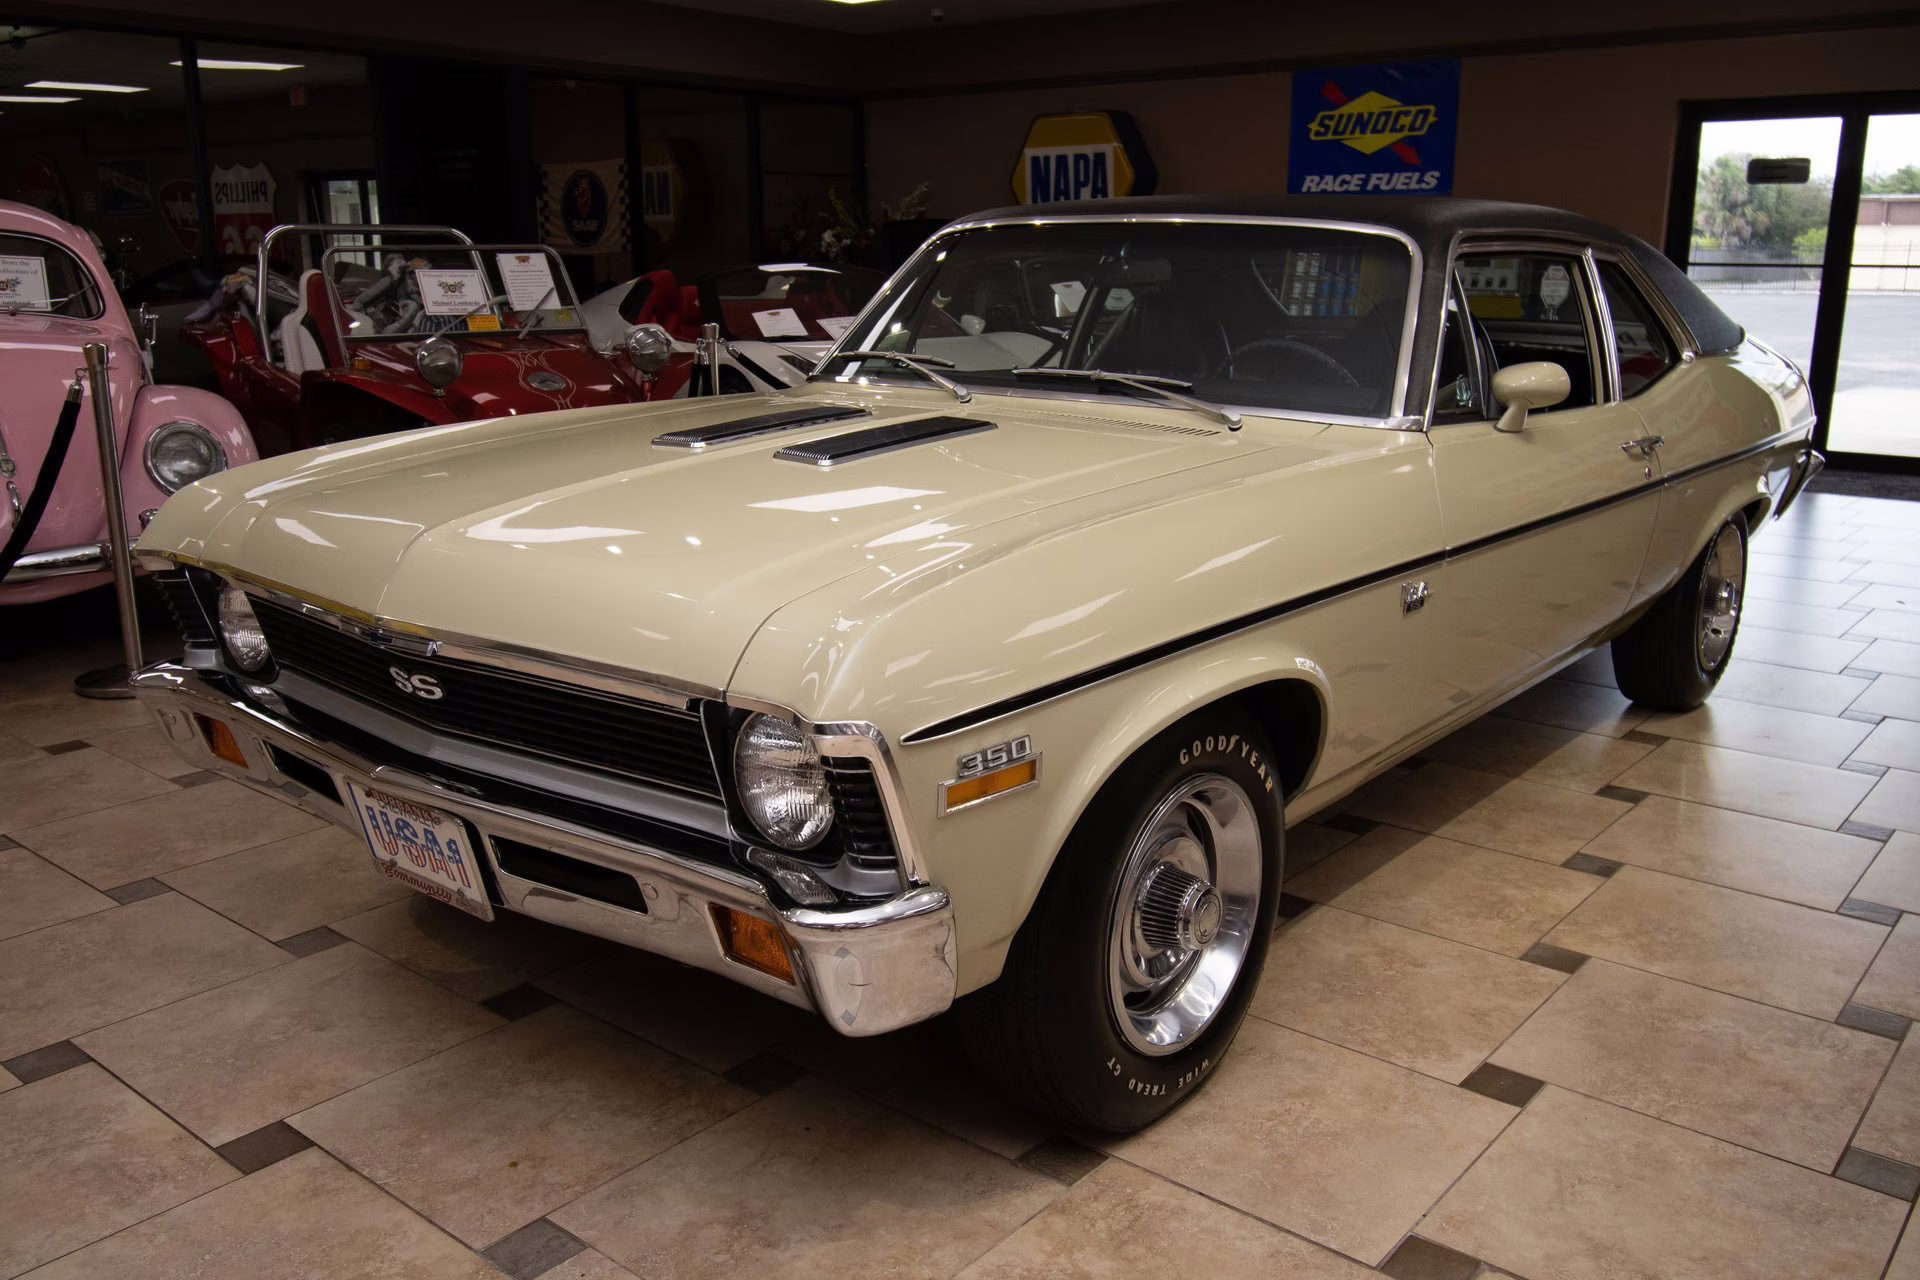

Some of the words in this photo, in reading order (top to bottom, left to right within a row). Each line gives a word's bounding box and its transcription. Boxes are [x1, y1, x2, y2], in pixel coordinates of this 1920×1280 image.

[1313, 108, 1432, 137] SUNOCO
[1030, 152, 1109, 204] NAPA
[1301, 173, 1366, 193] RACE
[1366, 170, 1441, 191] FUELS
[389, 666, 443, 700] SS
[957, 735, 1032, 778] 350
[1179, 734, 1273, 793] GOODYEAR
[381, 862, 452, 903] Community
[1128, 1078, 1166, 1096] TREAD
[1177, 1059, 1209, 1088] WIDE
